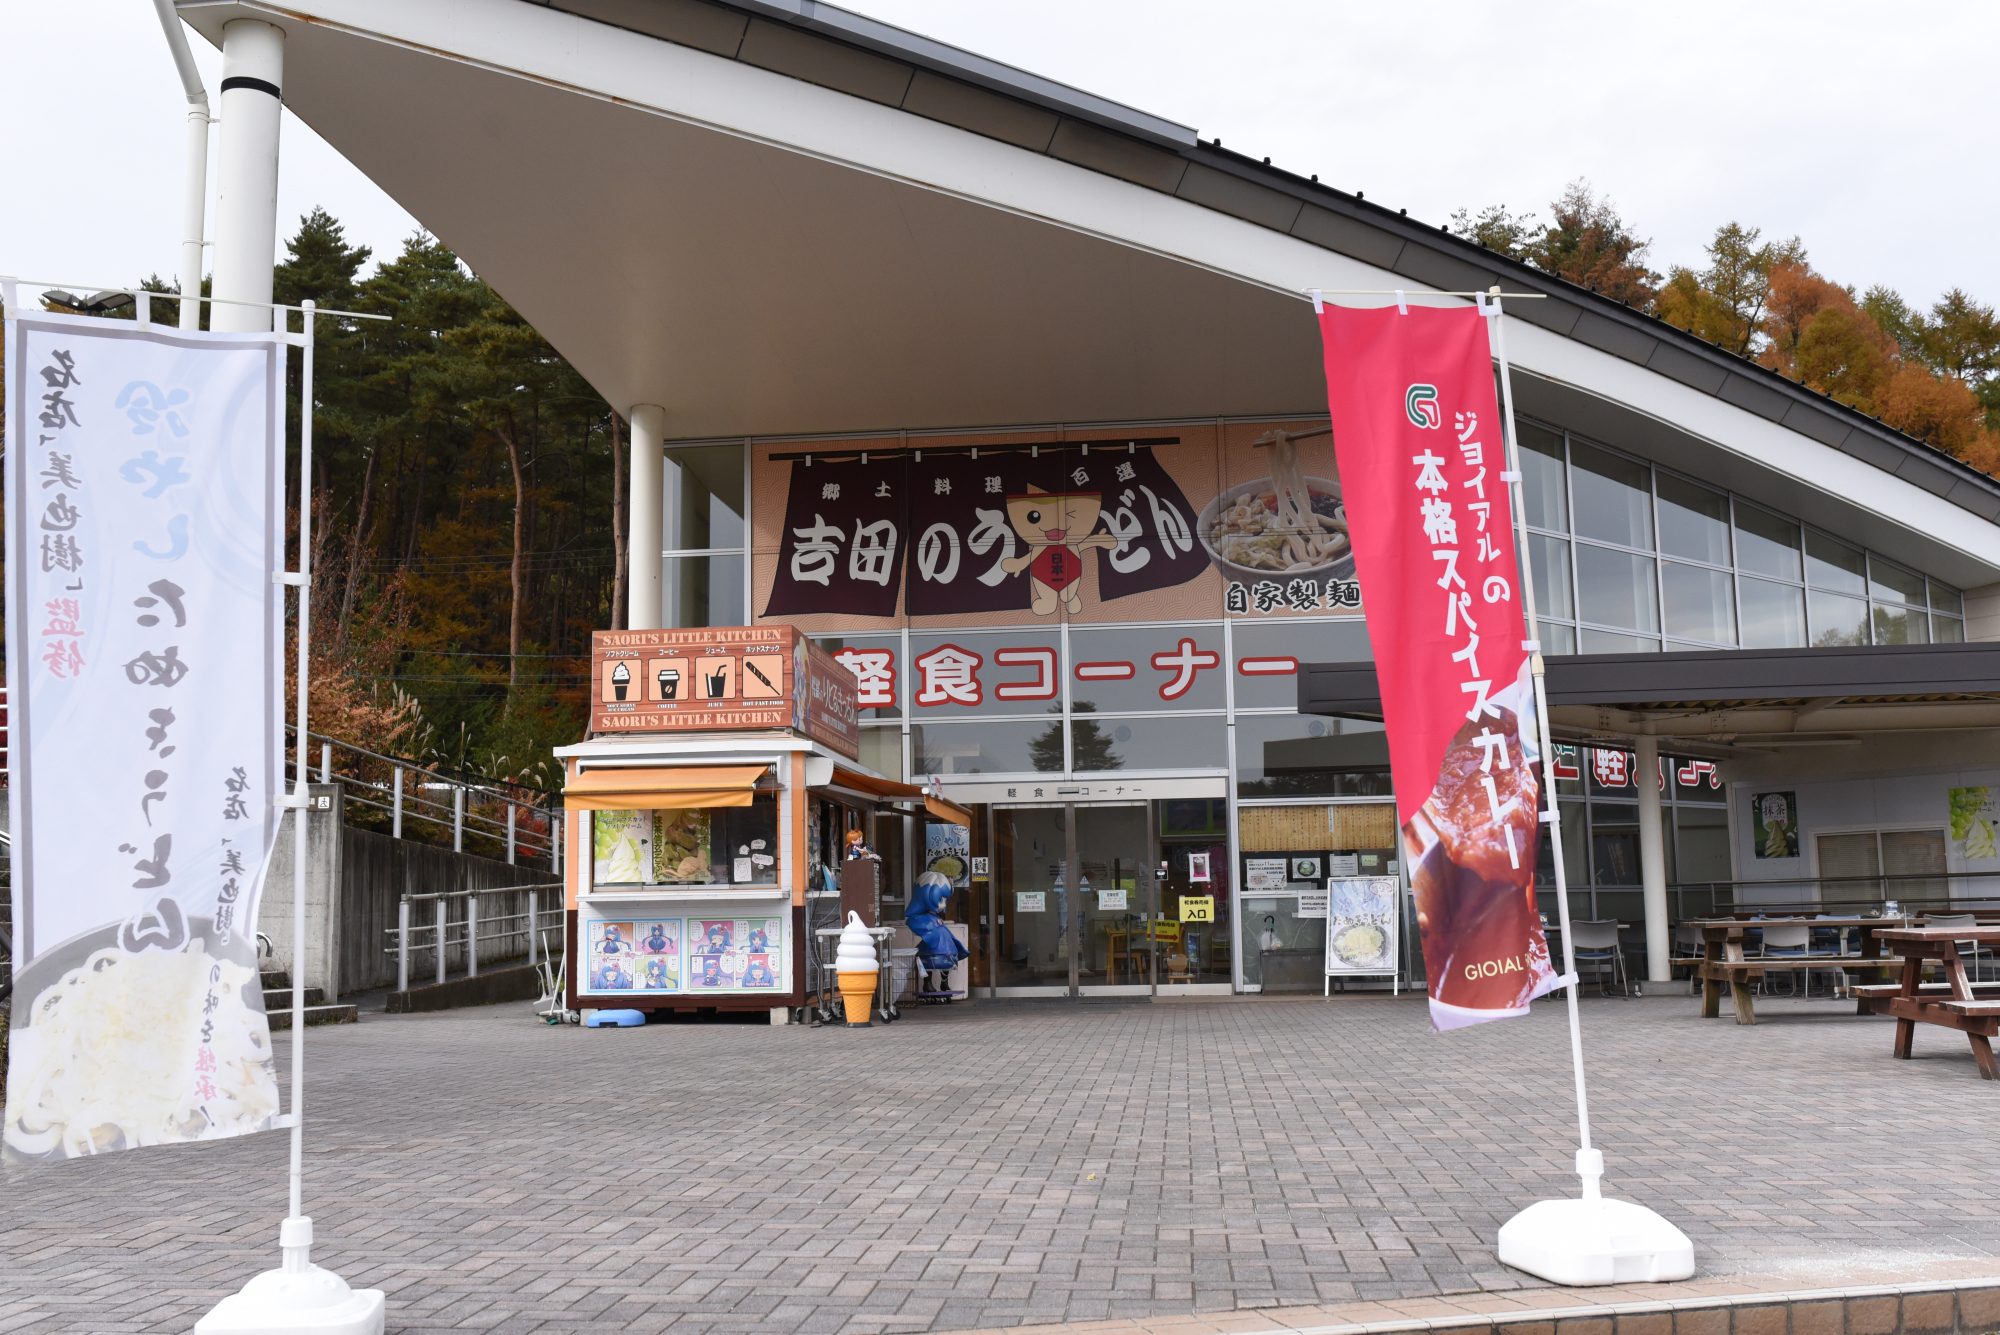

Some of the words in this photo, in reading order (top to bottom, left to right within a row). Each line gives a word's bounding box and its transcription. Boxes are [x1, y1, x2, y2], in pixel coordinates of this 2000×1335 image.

[1454, 411, 1511, 604] ジョイアルの
[790, 484, 1194, 587] 吉田のうどん
[1051, 552, 1064, 582] 日本一
[1226, 579, 1361, 614] 自家製麺
[602, 633, 660, 646] SAORI'S
[663, 631, 712, 644] LITTLE
[715, 629, 782, 642] KITCHEN
[605, 650, 639, 658] ソフトクリーム
[745, 645, 780, 653] ホットスナック
[1412, 449, 1520, 871] 本格スパイスカレー
[832, 637, 1299, 708] 軽食コーナー
[602, 715, 659, 728] SAORI'S
[662, 713, 712, 726] LITTLE
[715, 711, 782, 725] KITCHEN
[1007, 786, 1142, 798] 軽食コーナー
[1763, 804, 1786, 816] 抹茶
[930, 836, 965, 847] 冷やし
[1187, 909, 1207, 919] 入口
[1464, 955, 1524, 980] GIOIAL
